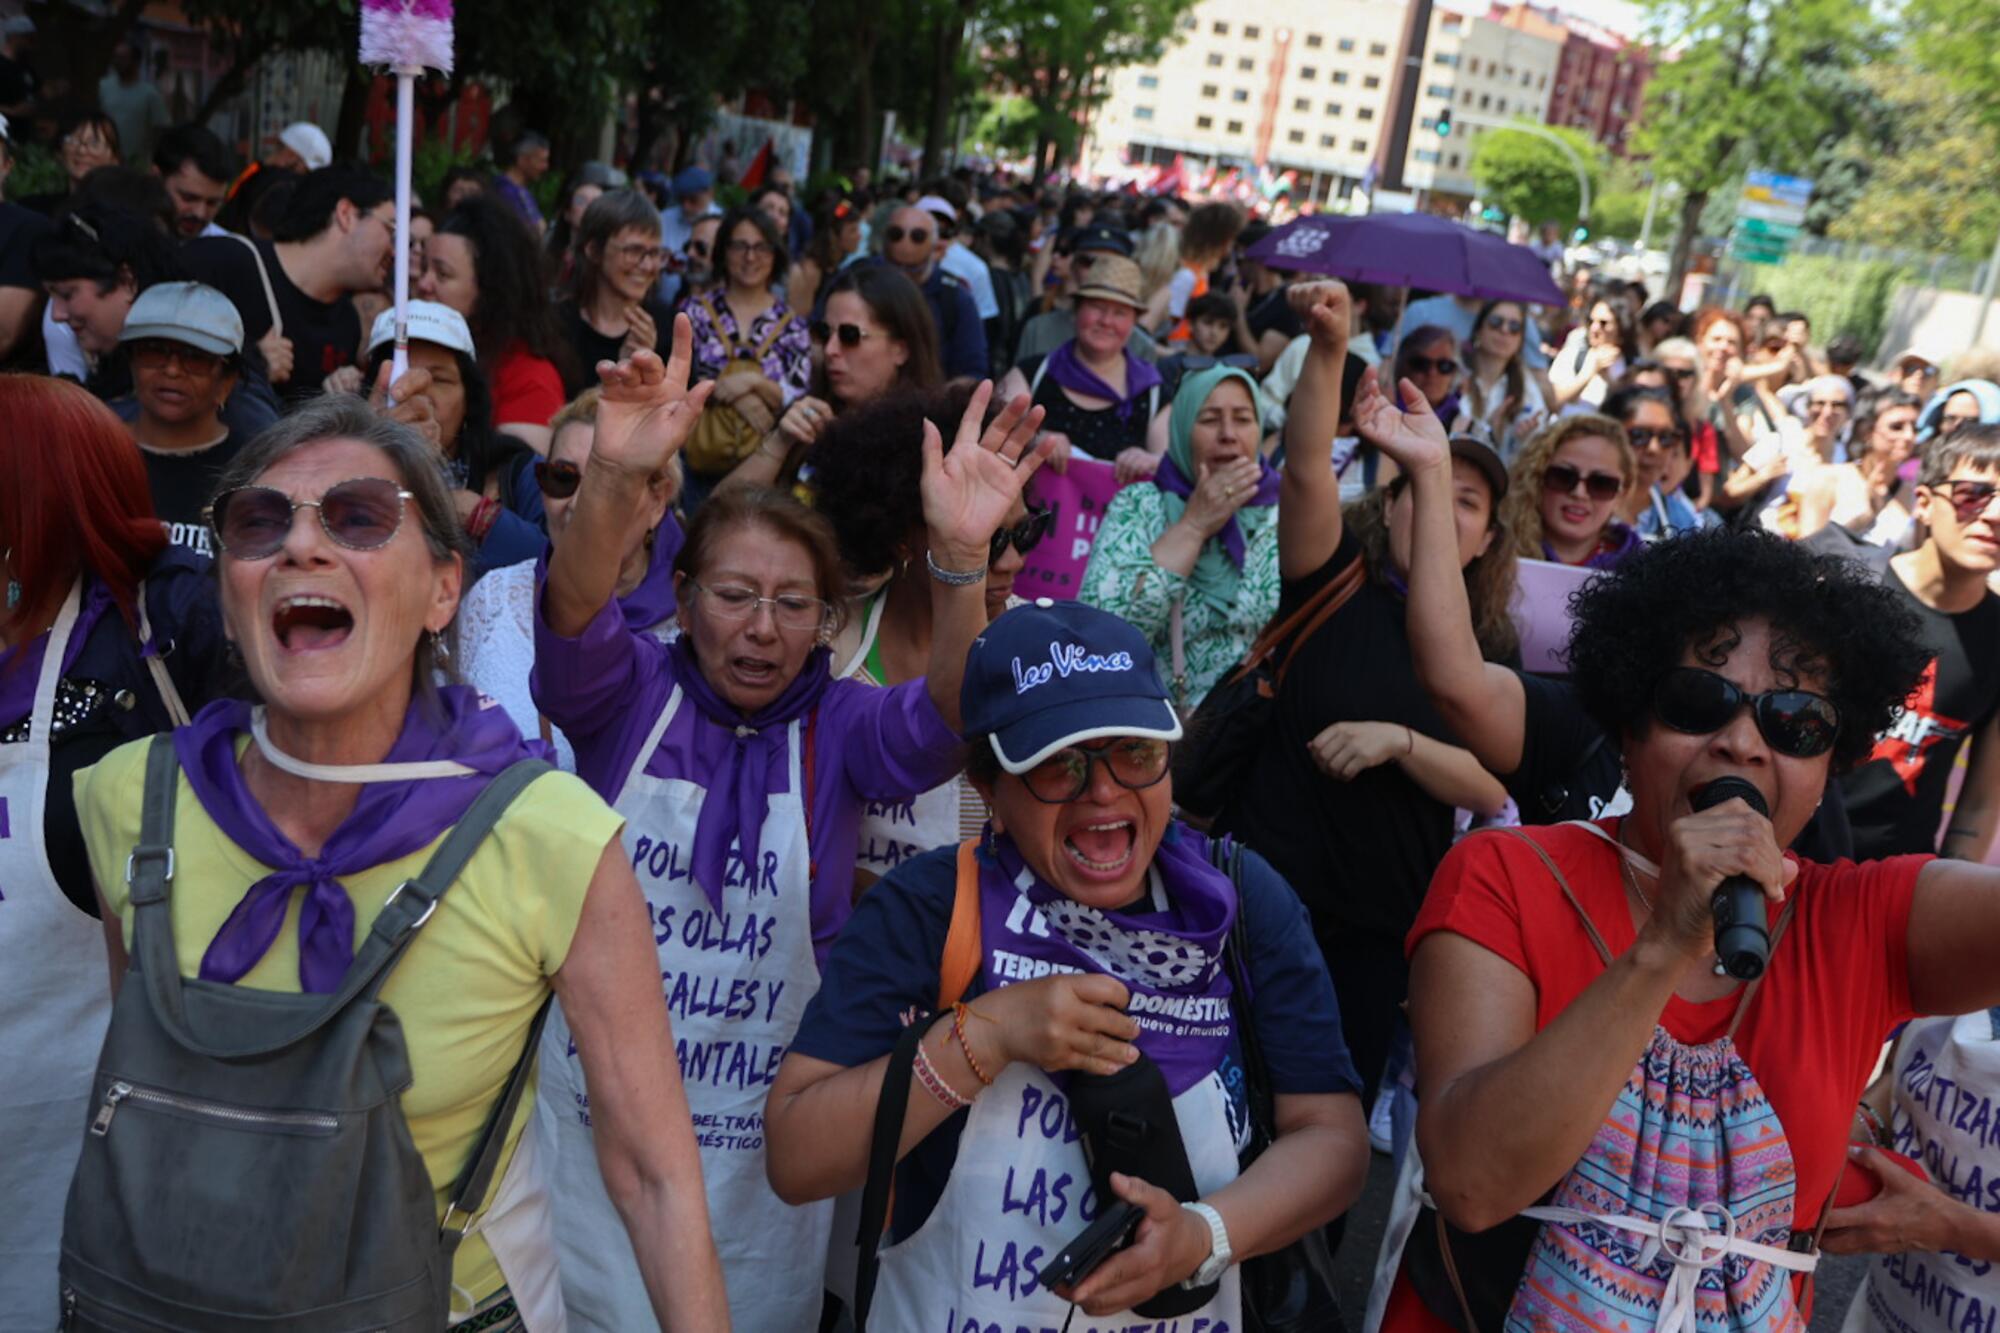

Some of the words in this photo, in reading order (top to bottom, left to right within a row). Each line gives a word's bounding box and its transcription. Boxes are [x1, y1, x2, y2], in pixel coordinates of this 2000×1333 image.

[1012, 656, 1053, 695] Leo
[1050, 641, 1133, 678] Vince
[682, 909, 777, 960] OLLAS
[766, 980, 785, 1024] Y
[1176, 1025, 1189, 1038] el
[1191, 1027, 1230, 1038] mundo
[1017, 1083, 1080, 1144] POL
[1002, 1166, 1072, 1226] LAS
[973, 1240, 1044, 1302] LAS
